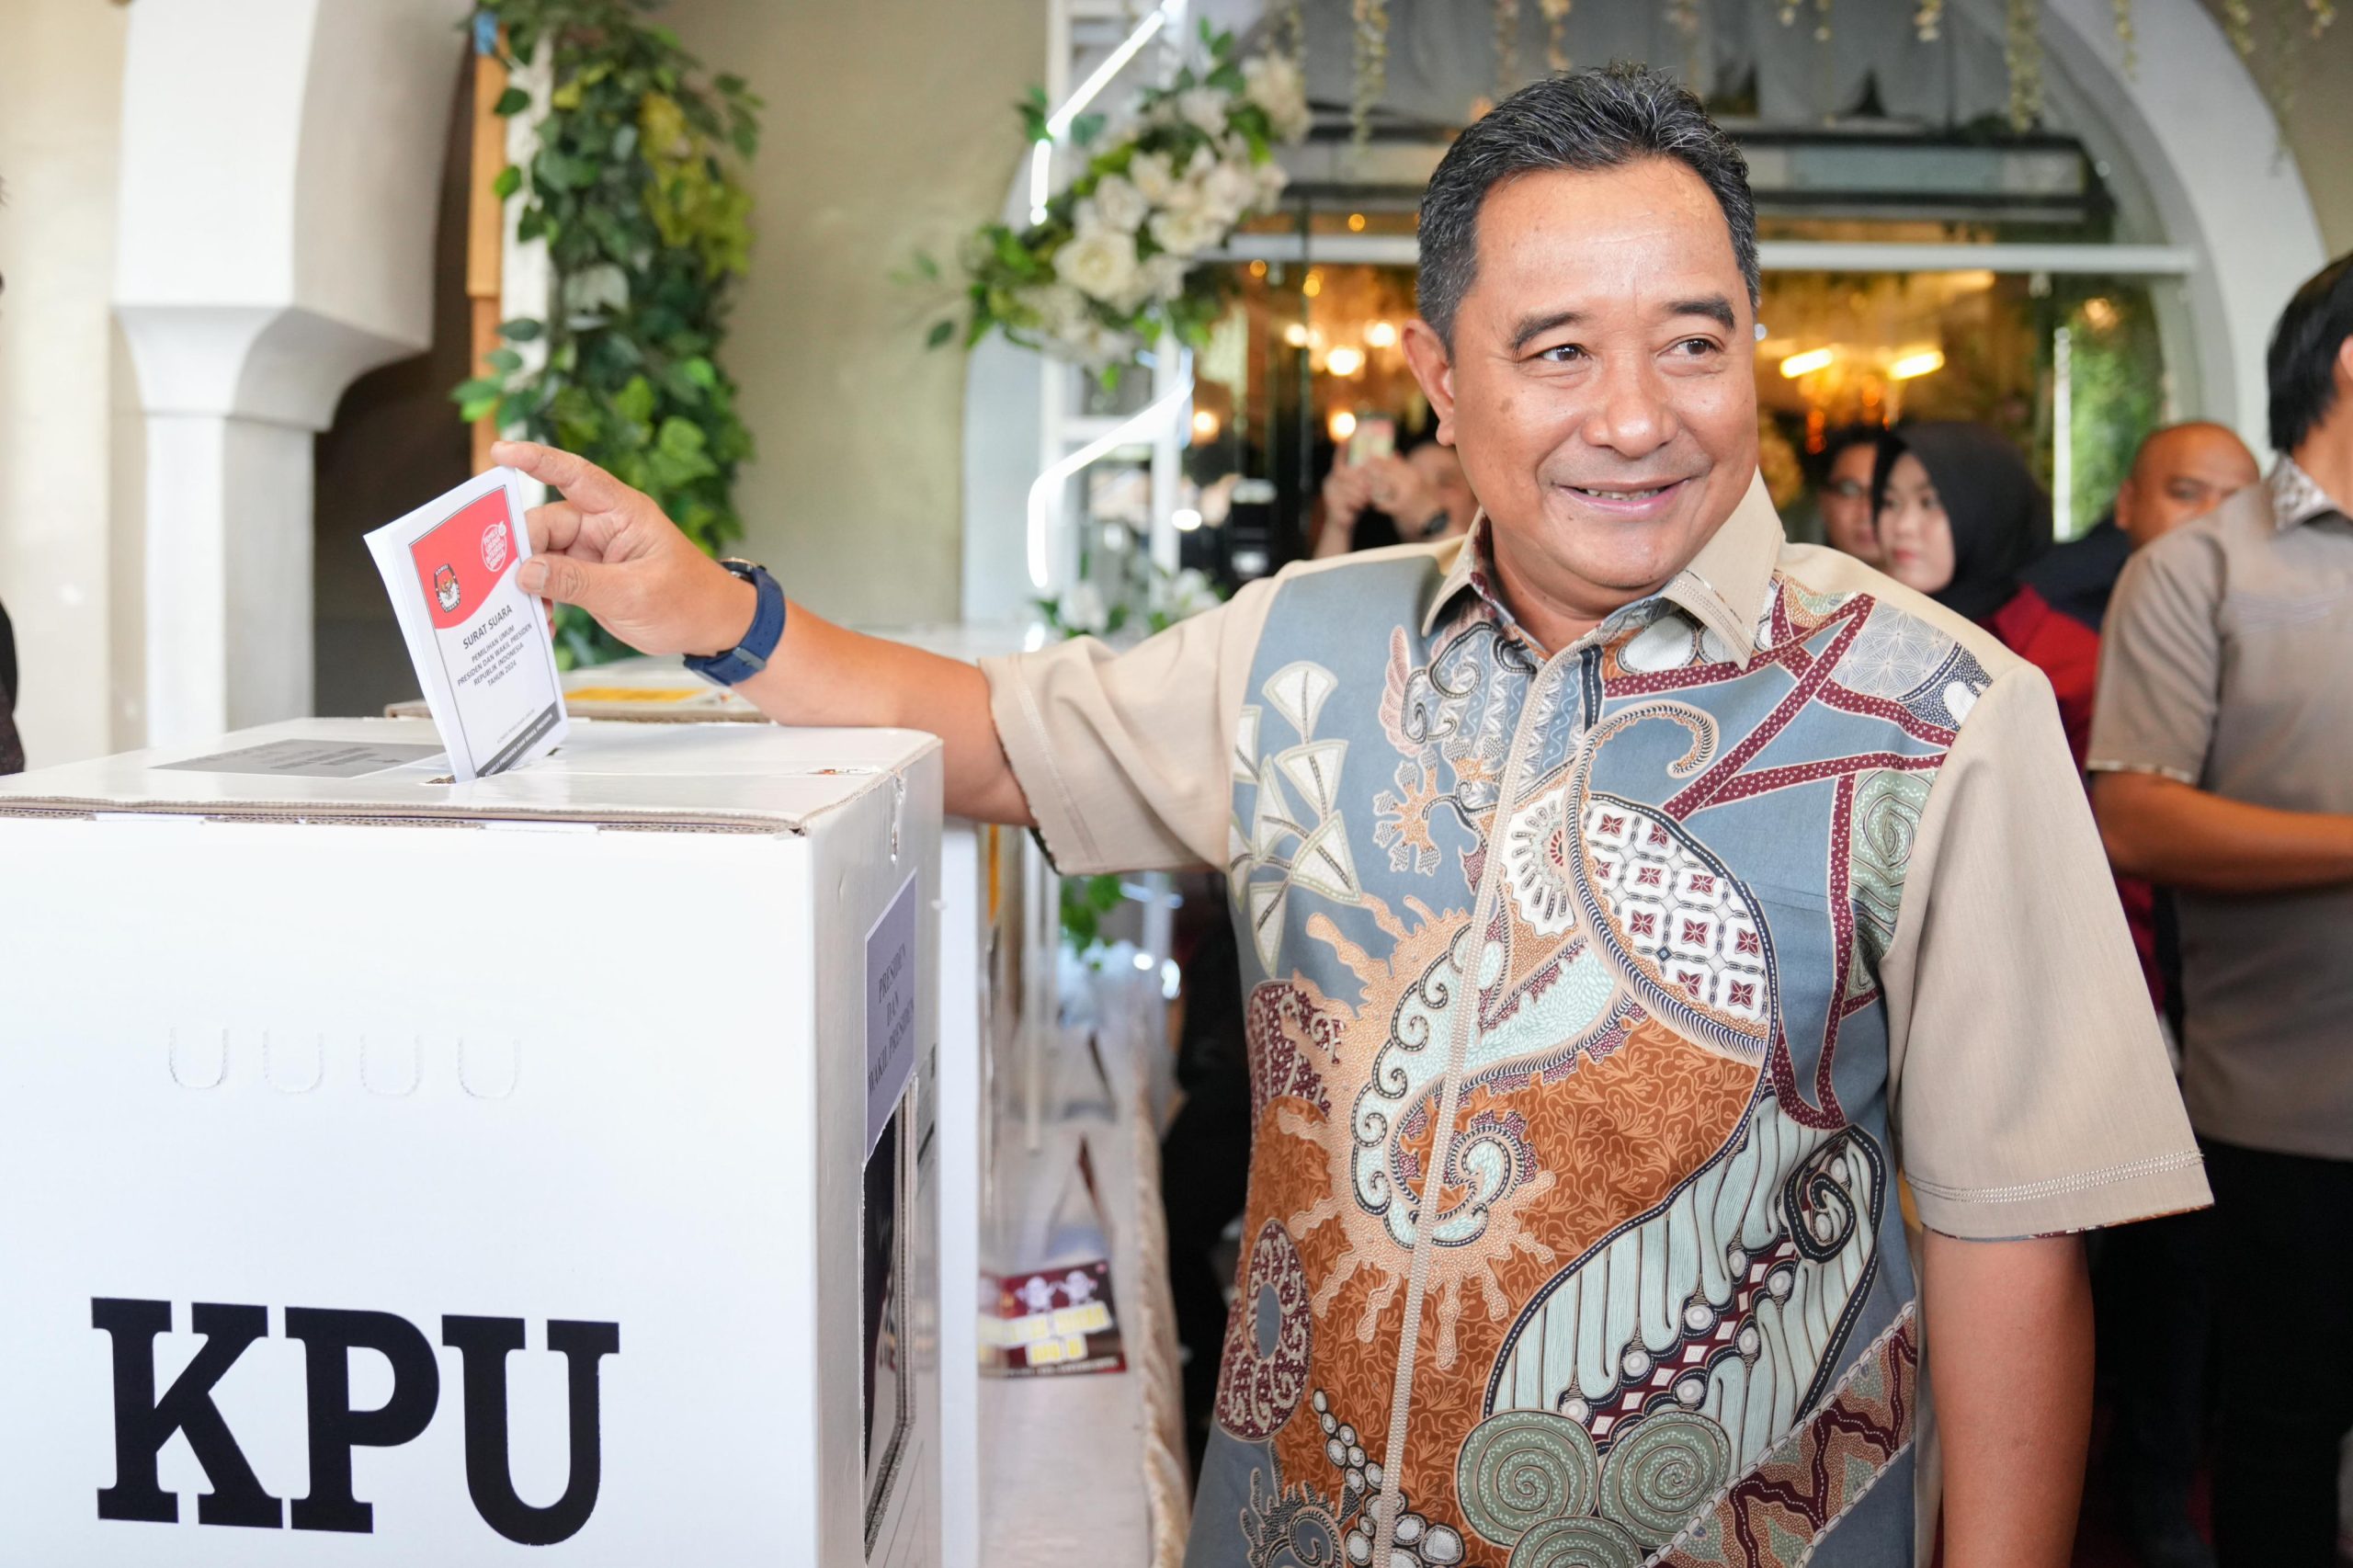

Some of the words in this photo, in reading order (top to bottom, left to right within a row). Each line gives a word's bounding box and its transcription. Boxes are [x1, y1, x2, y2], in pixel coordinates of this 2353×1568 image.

[462, 623, 488, 650] SURAT
[487, 605, 513, 630] SUARA
[472, 638, 499, 664] PEMILIHAN
[498, 624, 515, 642] UMUM
[457, 665, 483, 687] PRESIDEN
[483, 653, 494, 666] DAN
[494, 642, 510, 657] WAKIL
[510, 622, 532, 644] PRESIDEN
[473, 665, 497, 686] REPUBLIK
[497, 642, 524, 666] INDONESIA
[487, 671, 505, 687] TAHUN
[505, 660, 517, 674] 2024
[879, 942, 906, 1005] PRESIDEN
[886, 990, 899, 1028] DAN
[869, 1046, 889, 1096] WAKIL
[91, 1297, 620, 1547] KPU
